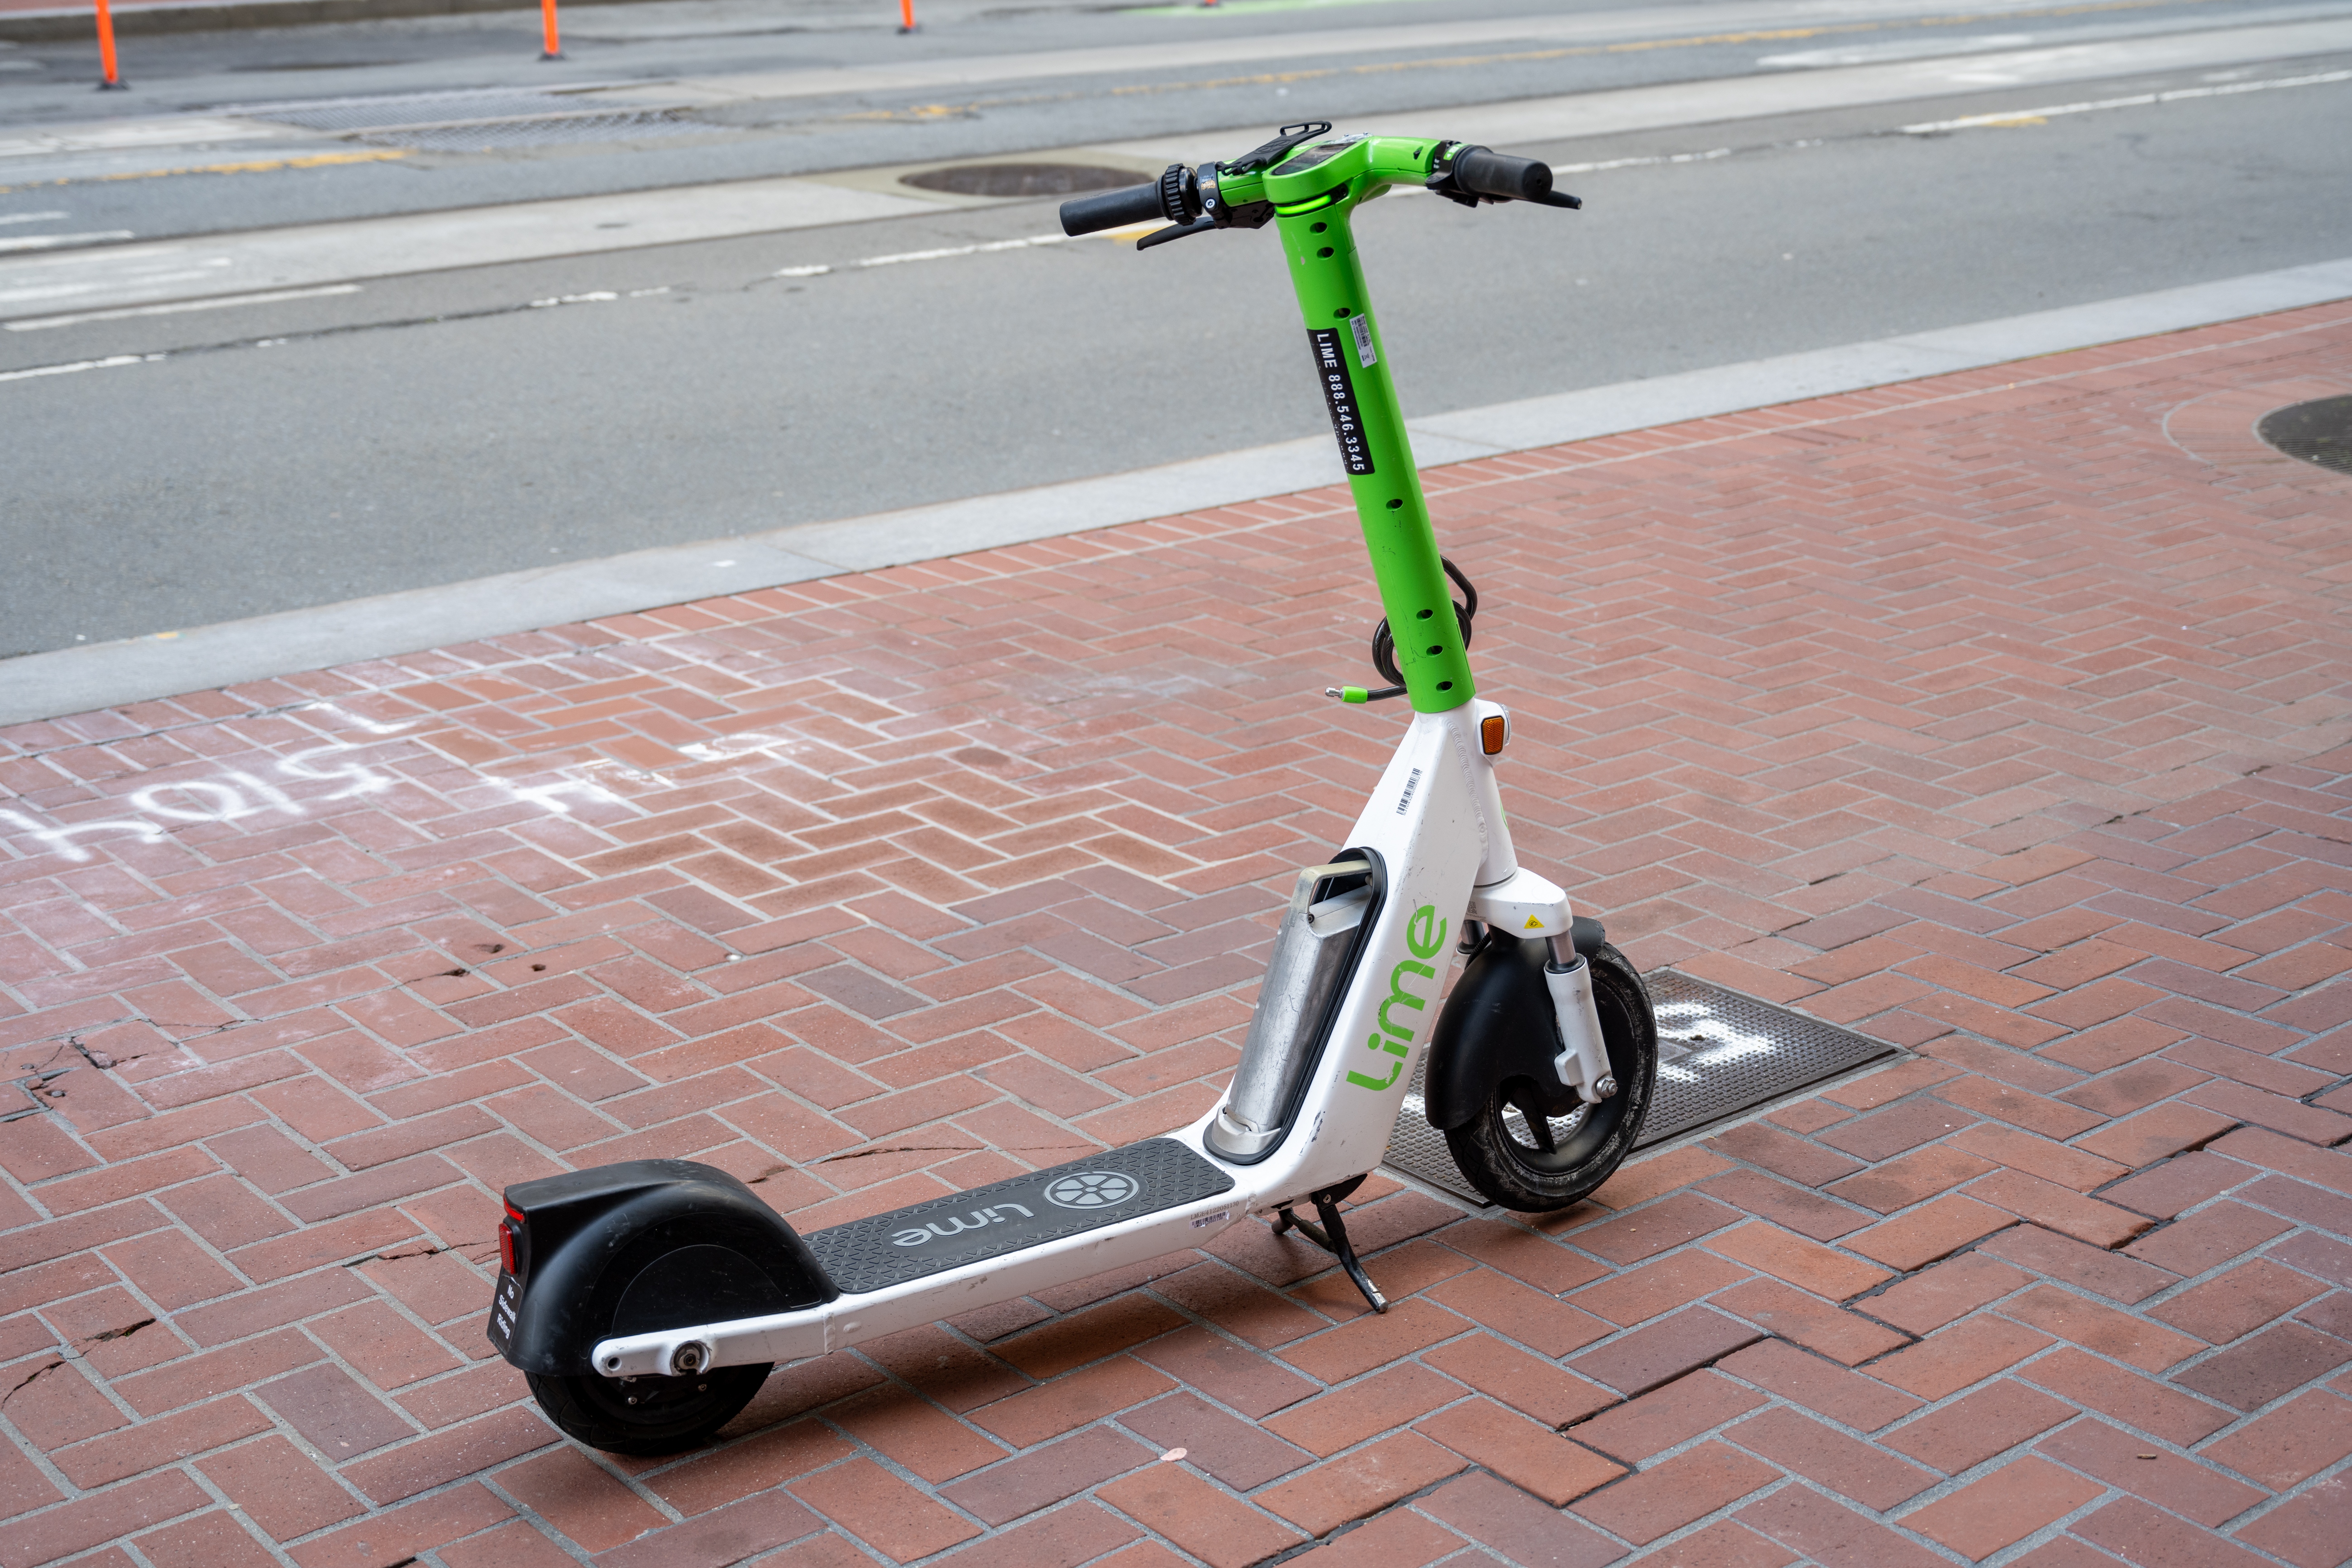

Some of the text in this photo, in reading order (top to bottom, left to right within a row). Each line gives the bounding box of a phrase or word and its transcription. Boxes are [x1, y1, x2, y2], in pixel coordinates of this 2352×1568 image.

[1317, 333, 1365, 470] LIME 888.546.3345
[1346, 905, 1447, 1091] Lime
[890, 1203, 1036, 1247] Lime
[1190, 1200, 1239, 1220] LMGE4122051130
[507, 1285, 514, 1299] No
[499, 1294, 516, 1324] Sidewalk
[497, 1313, 510, 1339] Riding
